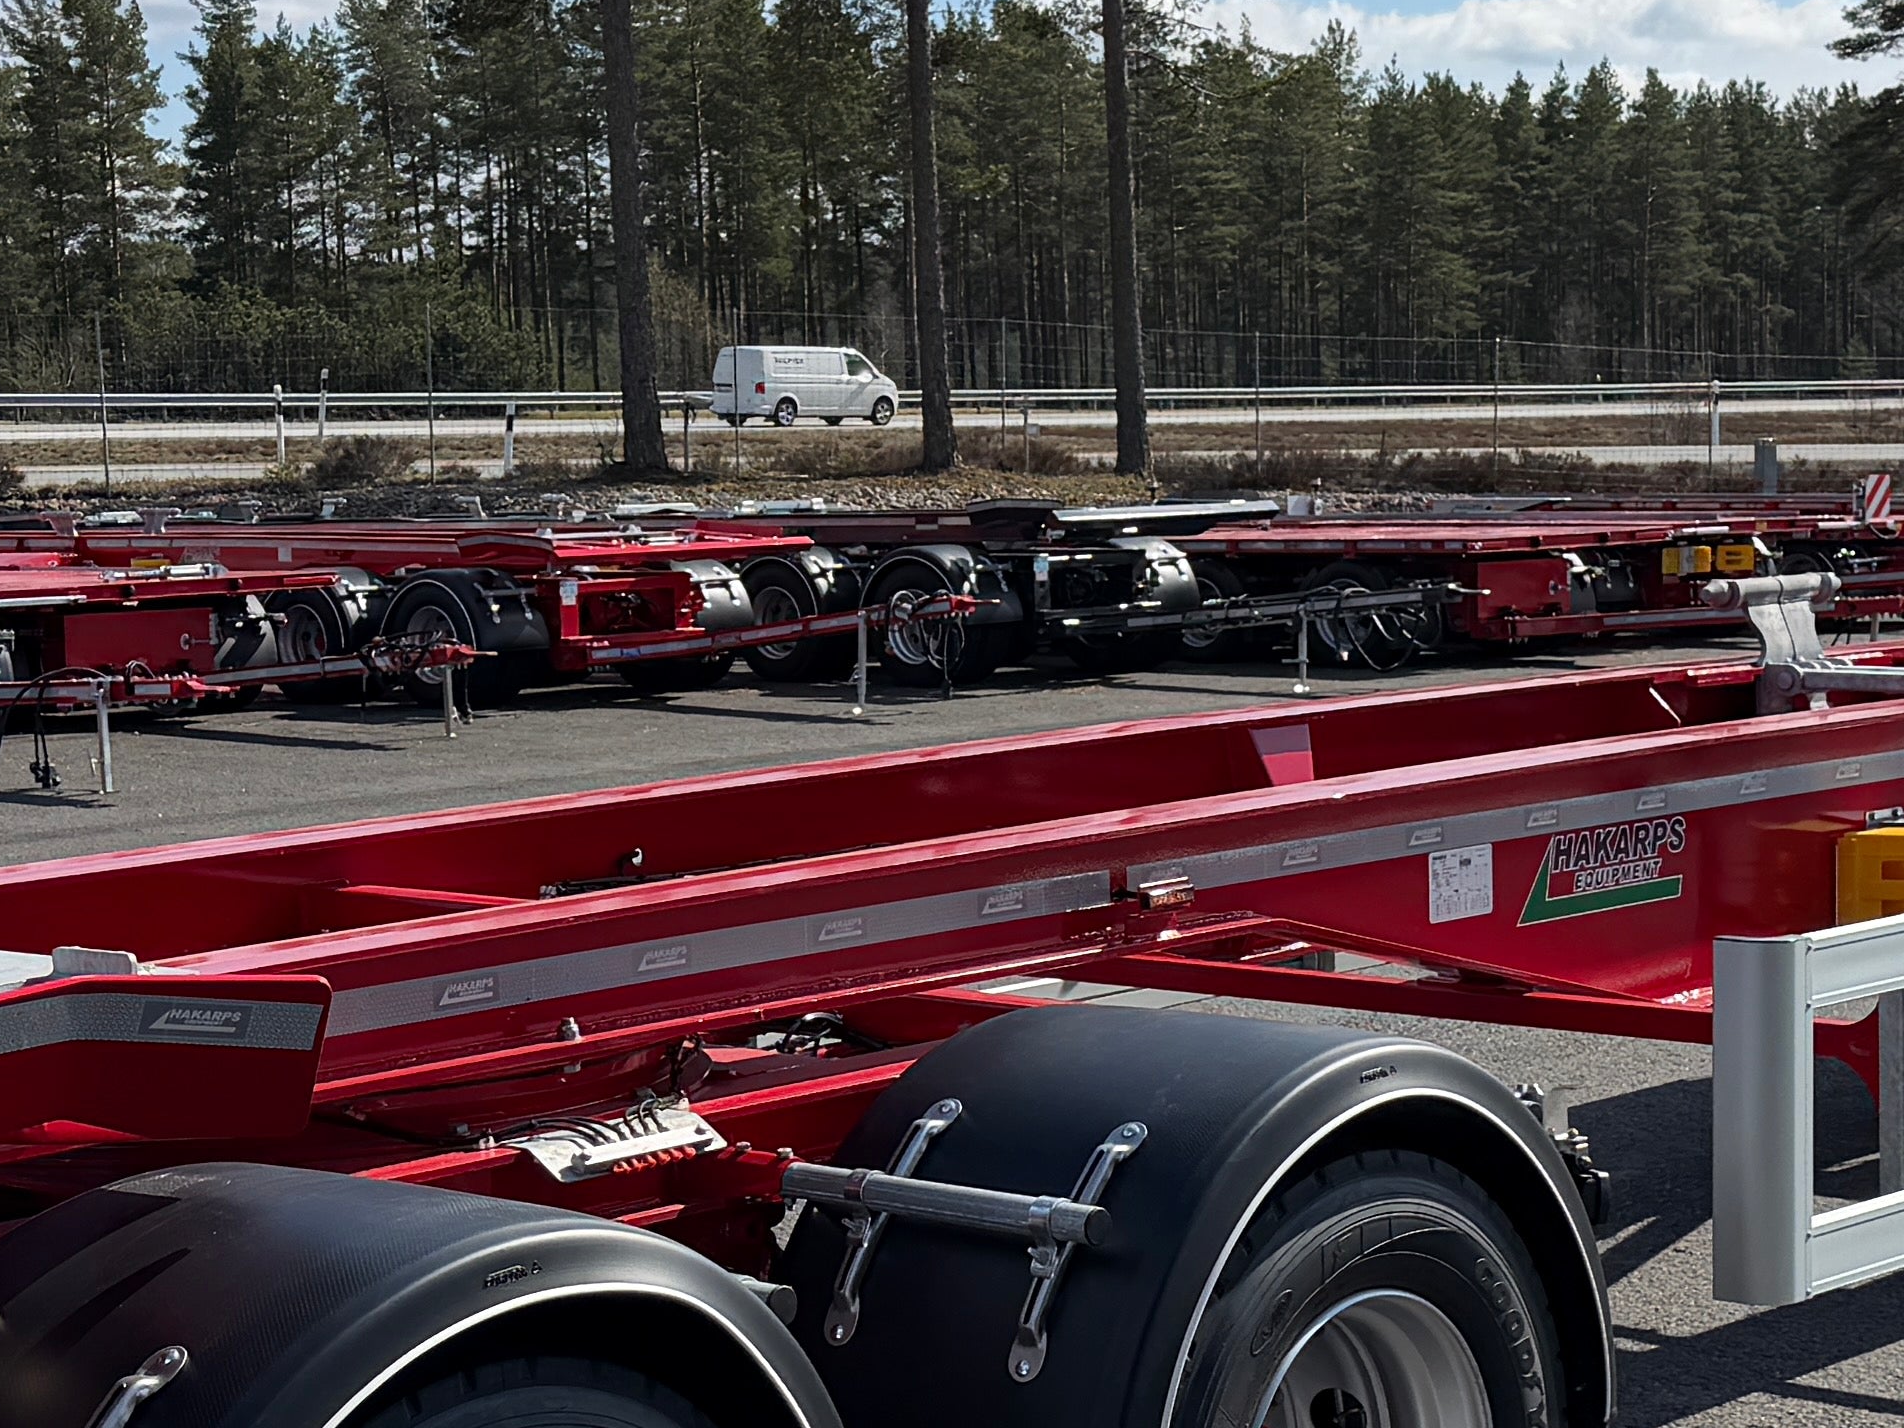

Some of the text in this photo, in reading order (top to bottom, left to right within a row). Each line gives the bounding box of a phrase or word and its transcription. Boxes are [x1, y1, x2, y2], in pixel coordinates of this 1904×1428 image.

[1552, 816, 1686, 873] HAKARPS
[1573, 858, 1662, 892] EQUIPMENT
[169, 1008, 242, 1022] HAKARPS
